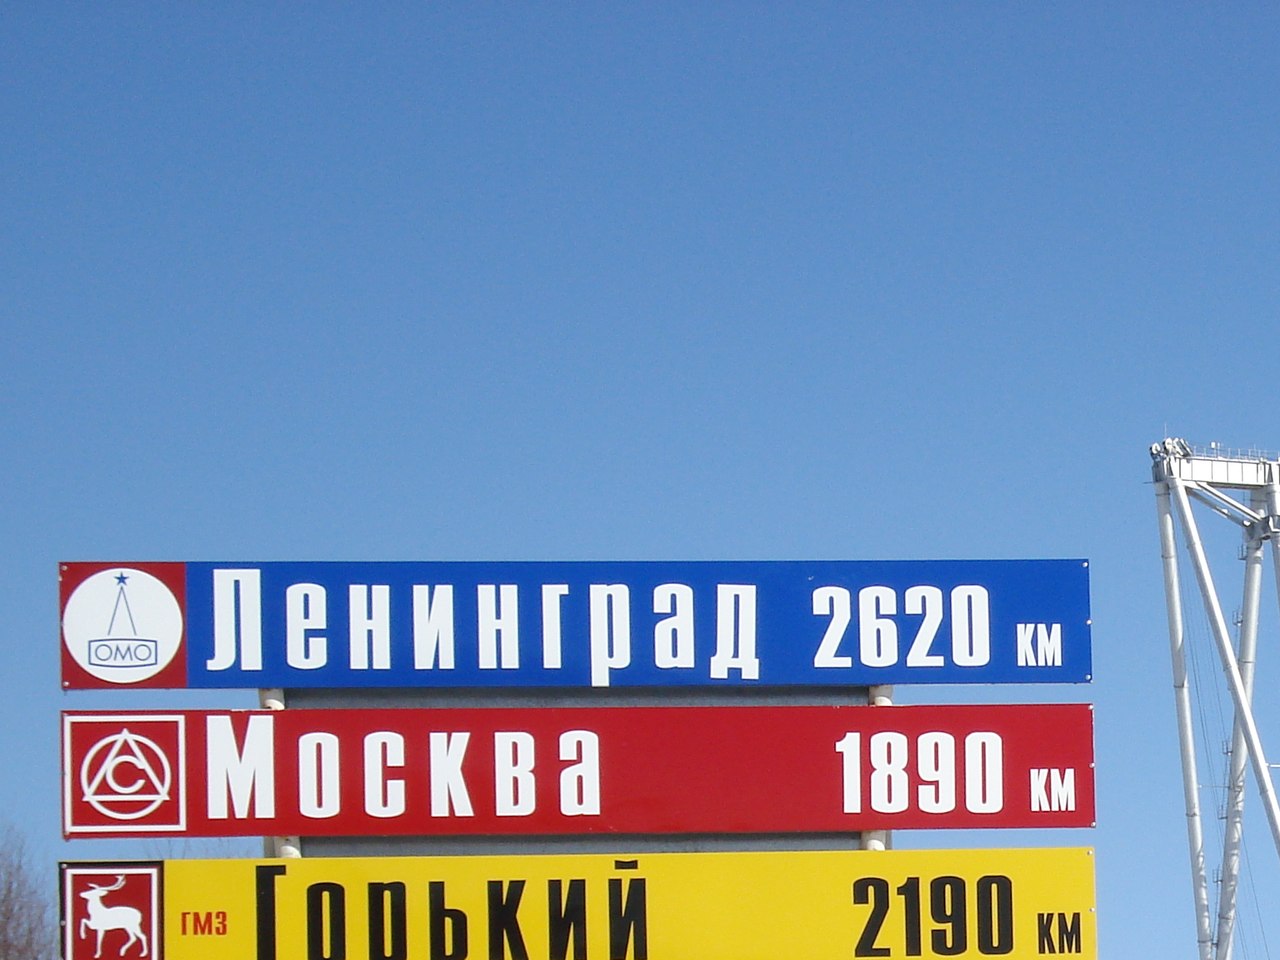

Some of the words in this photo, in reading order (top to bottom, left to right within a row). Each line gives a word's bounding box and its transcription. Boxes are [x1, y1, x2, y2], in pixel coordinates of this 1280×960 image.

[207, 568, 760, 687] Ленинград
[812, 585, 991, 668] 2620
[206, 714, 601, 819] Москва
[835, 731, 1004, 814] 1890
[181, 911, 228, 936] ГМЗ
[853, 875, 1013, 958] 2190
